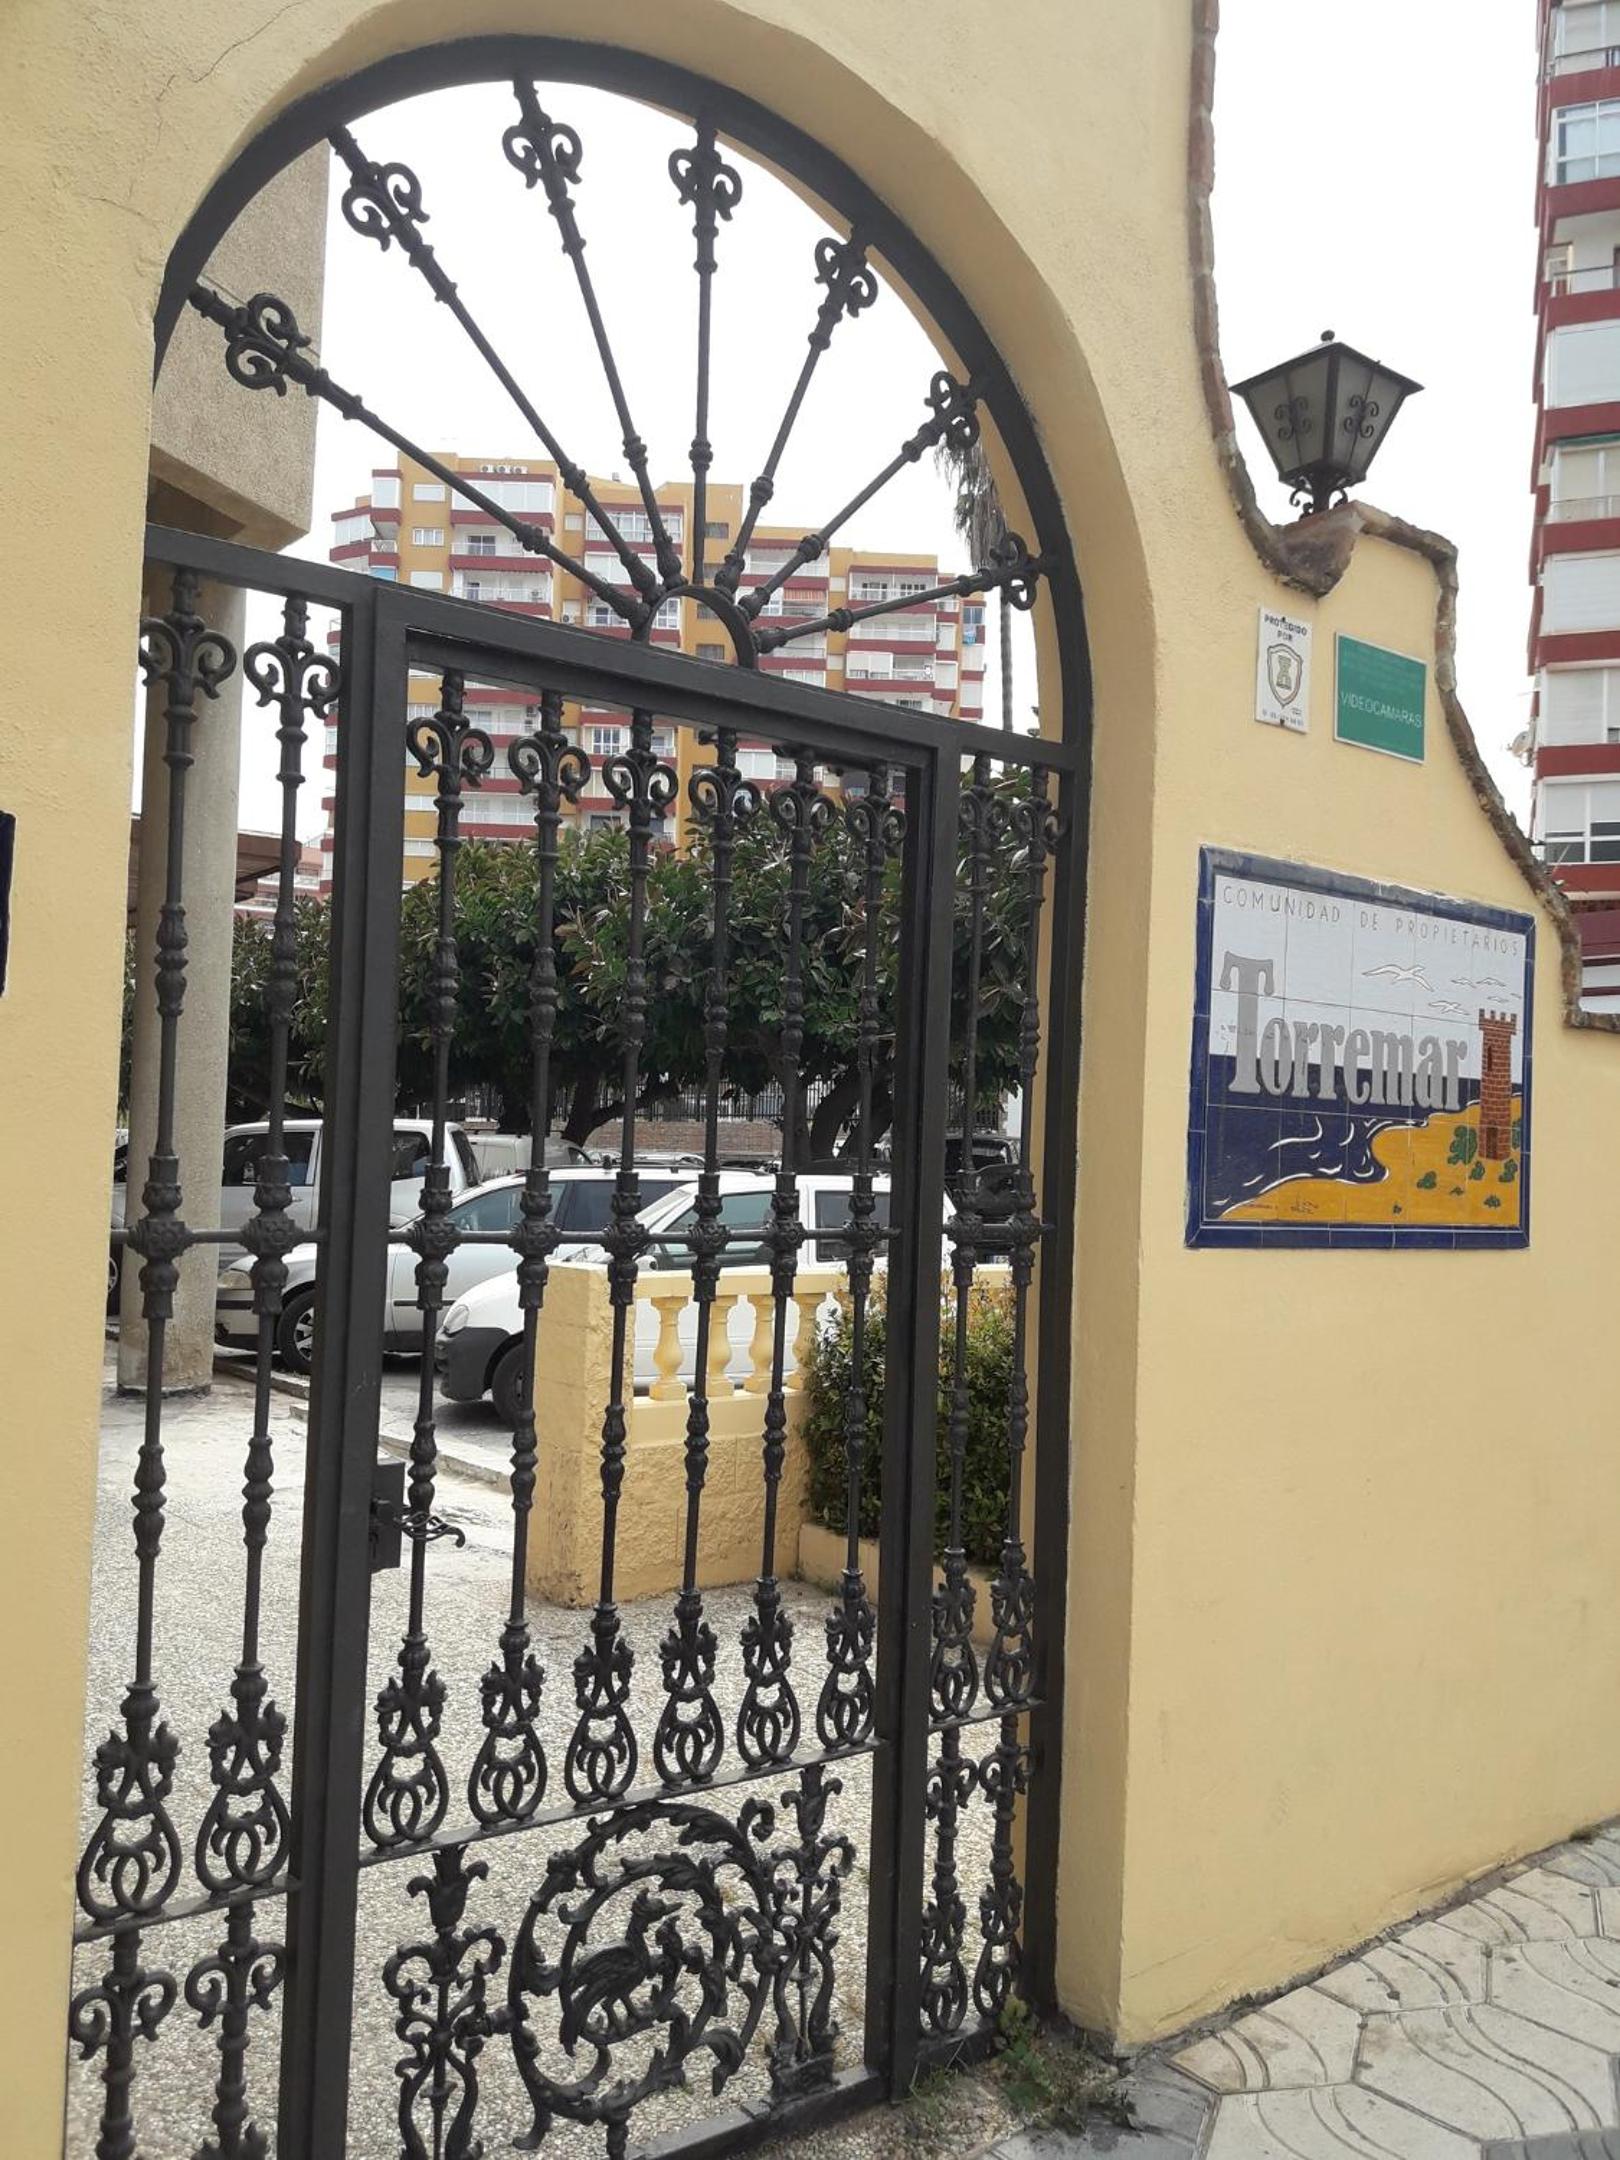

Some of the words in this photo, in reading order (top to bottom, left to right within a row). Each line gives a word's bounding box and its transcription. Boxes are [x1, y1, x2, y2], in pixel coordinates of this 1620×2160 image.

[1264, 614, 1307, 636] PROTEGIDO
[1277, 630, 1293, 641] POR
[1223, 886, 1341, 923] COMUNIDAD
[1360, 911, 1379, 931] DE
[1396, 917, 1519, 956] PROPIETARIOS
[1220, 951, 1468, 1111] Torremar
